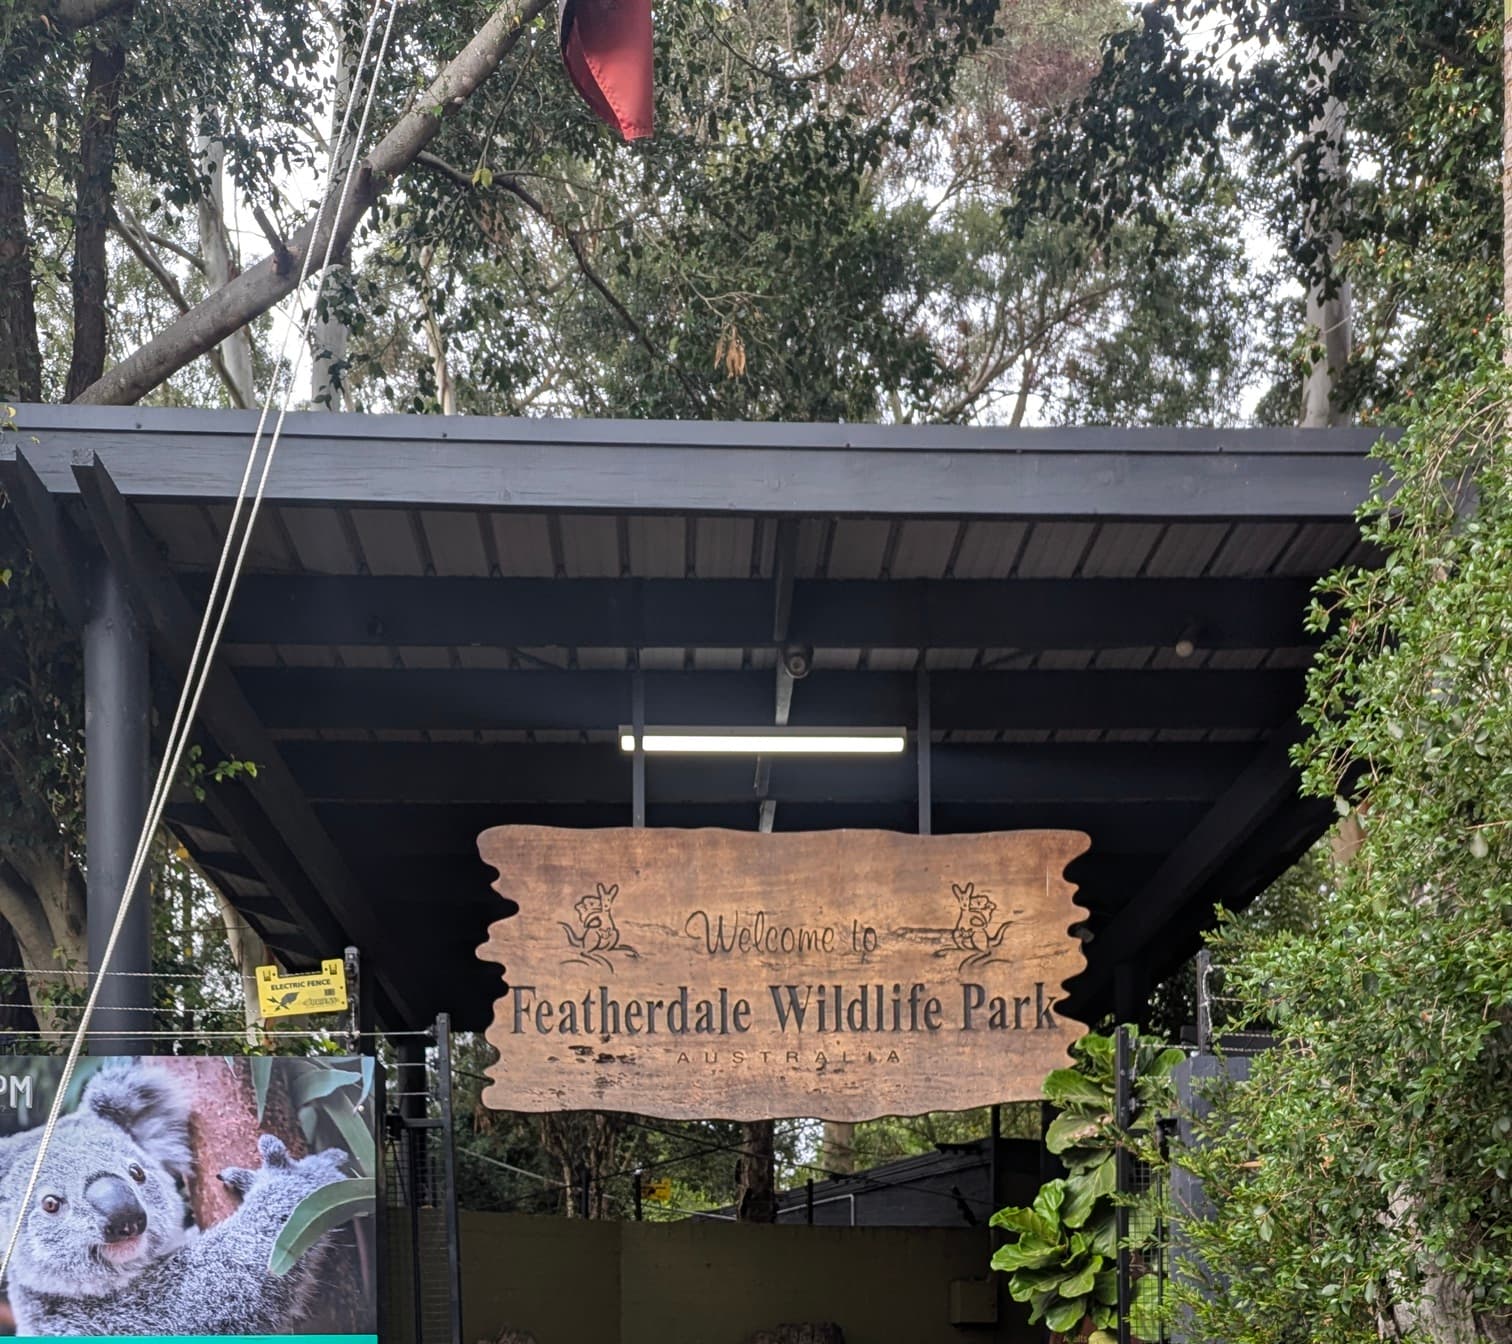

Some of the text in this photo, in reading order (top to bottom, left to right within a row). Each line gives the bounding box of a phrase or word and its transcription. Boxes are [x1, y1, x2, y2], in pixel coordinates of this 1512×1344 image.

[684, 910, 878, 954] Welcome to
[270, 979, 331, 991] ELECTRIC FENCE
[508, 981, 1058, 1036] Featherdale Wildlife Park
[676, 1050, 901, 1064] AUSTRALIA
